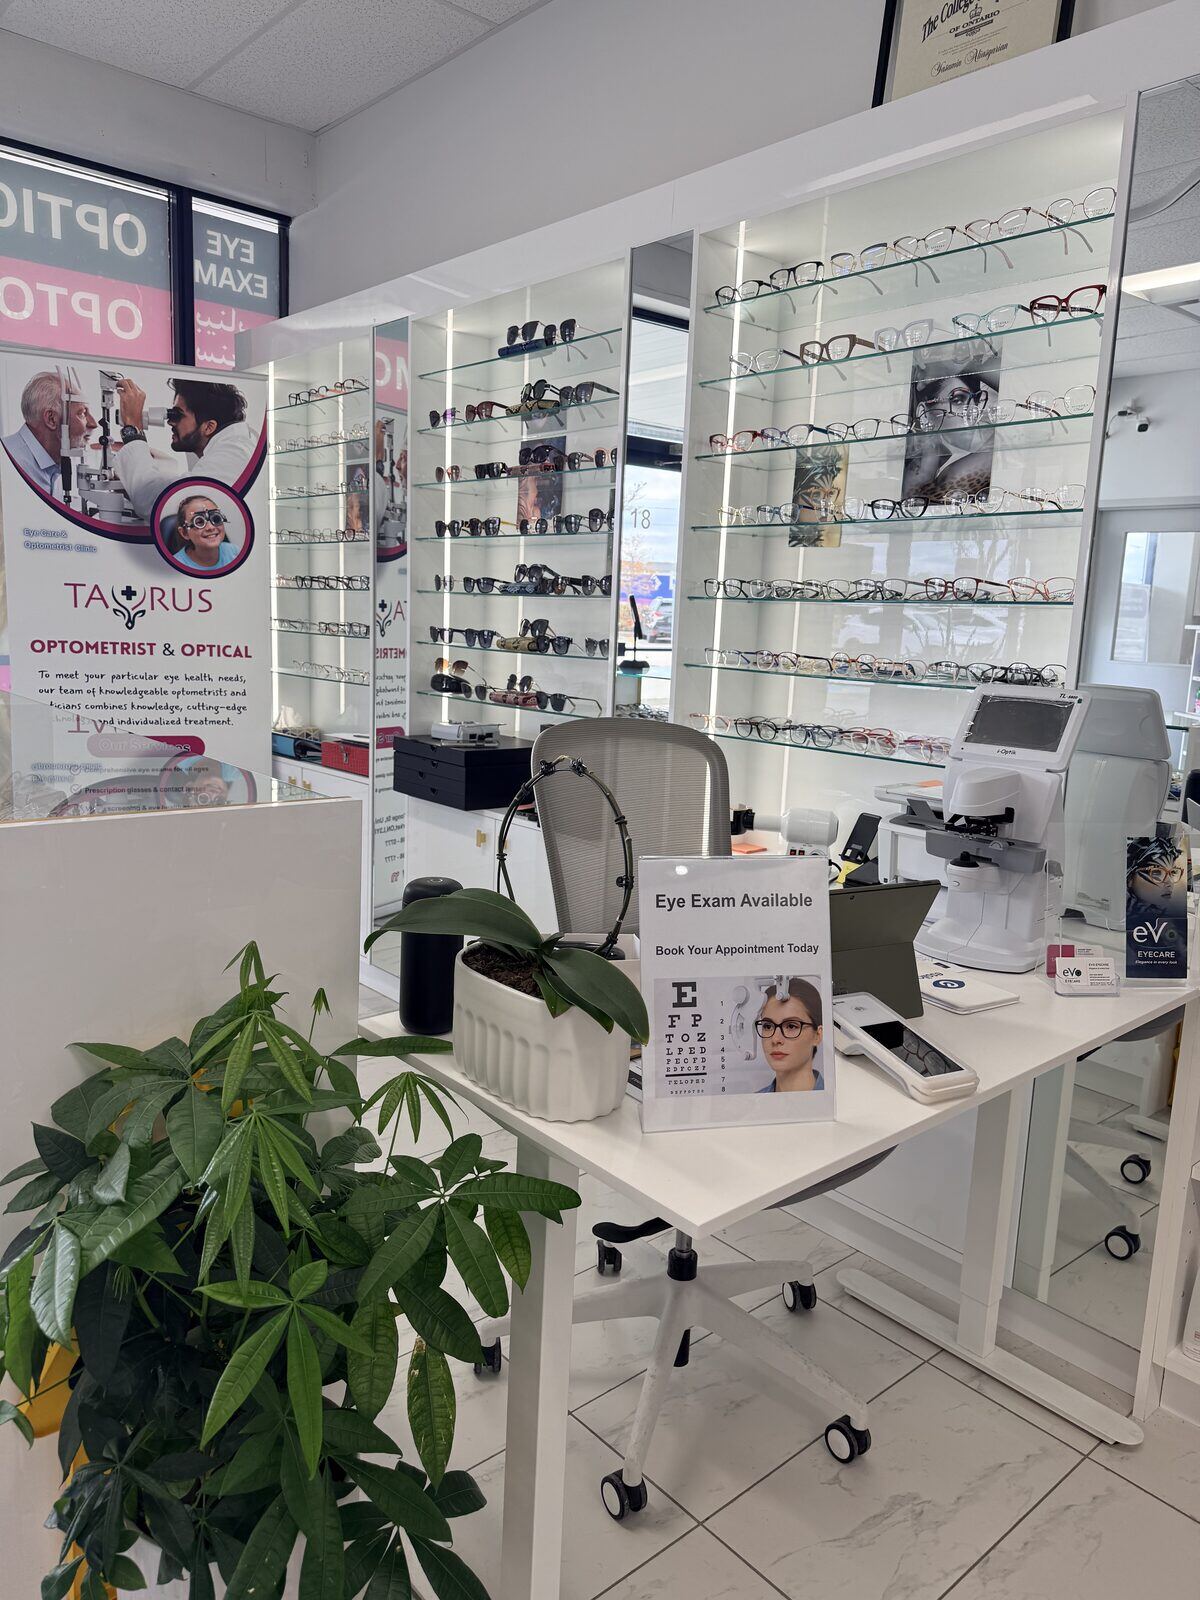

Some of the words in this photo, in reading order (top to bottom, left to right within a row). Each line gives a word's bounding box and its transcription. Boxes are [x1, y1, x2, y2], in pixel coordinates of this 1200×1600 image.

[949, 26, 961, 34] OF
[962, 9, 1001, 29] ONTARIO
[922, 15, 939, 43] The
[630, 507, 651, 530] 18
[23, 528, 39, 538] Eye
[40, 529, 60, 538] Care
[24, 541, 73, 551] Optometrist
[75, 544, 97, 553] Clinic
[30, 639, 157, 656] OPTOMETRIST
[162, 643, 176, 657] &
[180, 643, 253, 659] OPTICAL
[38, 670, 50, 679] To
[55, 670, 79, 679] meet
[85, 673, 106, 683] your
[111, 672, 159, 683] particular
[164, 674, 180, 685] eye
[184, 673, 213, 682] health
[218, 674, 247, 684] needs,
[59, 685, 83, 694] team
[86, 687, 96, 698] of
[99, 686, 169, 699] knowledgeable
[171, 687, 228, 699] optometrists
[230, 689, 247, 697] and
[85, 702, 127, 711] combines
[131, 701, 183, 715] knowledge,
[117, 717, 181, 726] individualized
[184, 717, 234, 726] treatment.
[85, 787, 126, 795] Prescription
[127, 786, 151, 794] glasses
[160, 785, 184, 793] contact
[655, 894, 686, 911] Eye
[691, 894, 736, 909] Exam
[740, 893, 813, 908] Available
[655, 945, 684, 956] Book
[687, 945, 713, 956] Your
[715, 944, 785, 957] Appointment
[787, 943, 819, 956] Today
[1137, 950, 1176, 958] EYECARE
[672, 982, 697, 1008] E
